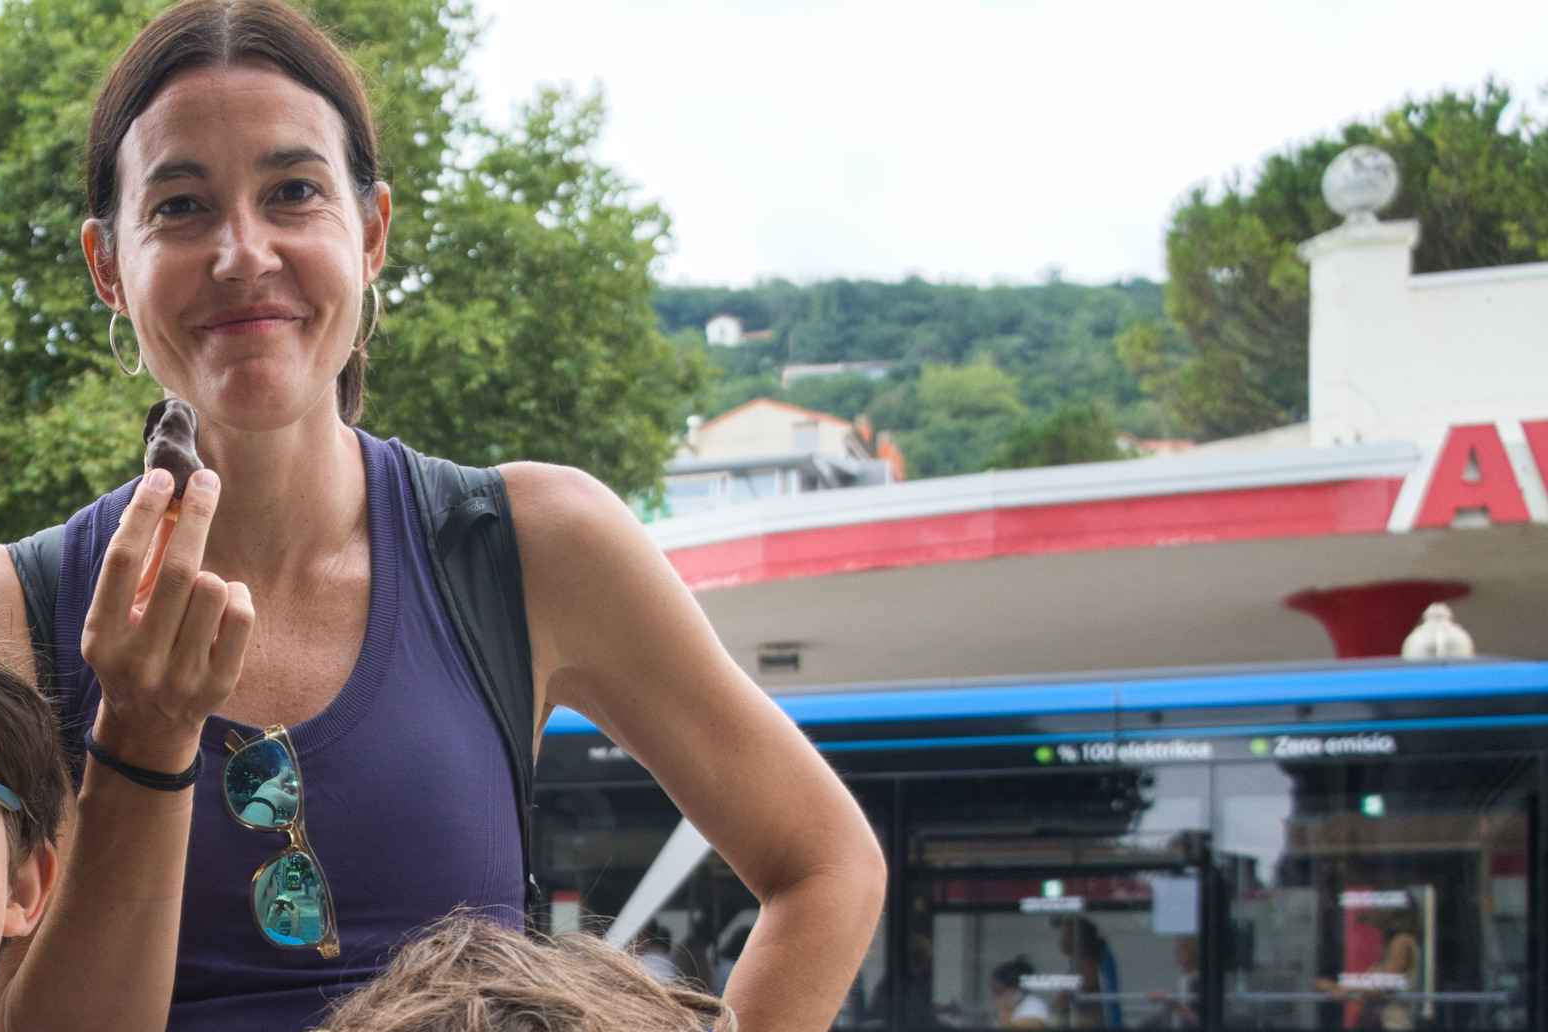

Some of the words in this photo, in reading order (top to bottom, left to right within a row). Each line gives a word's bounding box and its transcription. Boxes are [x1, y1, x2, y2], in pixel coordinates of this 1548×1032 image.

[1081, 741, 1116, 762] 100
[1117, 739, 1213, 762] elektrikoa
[1273, 735, 1324, 757] Zero
